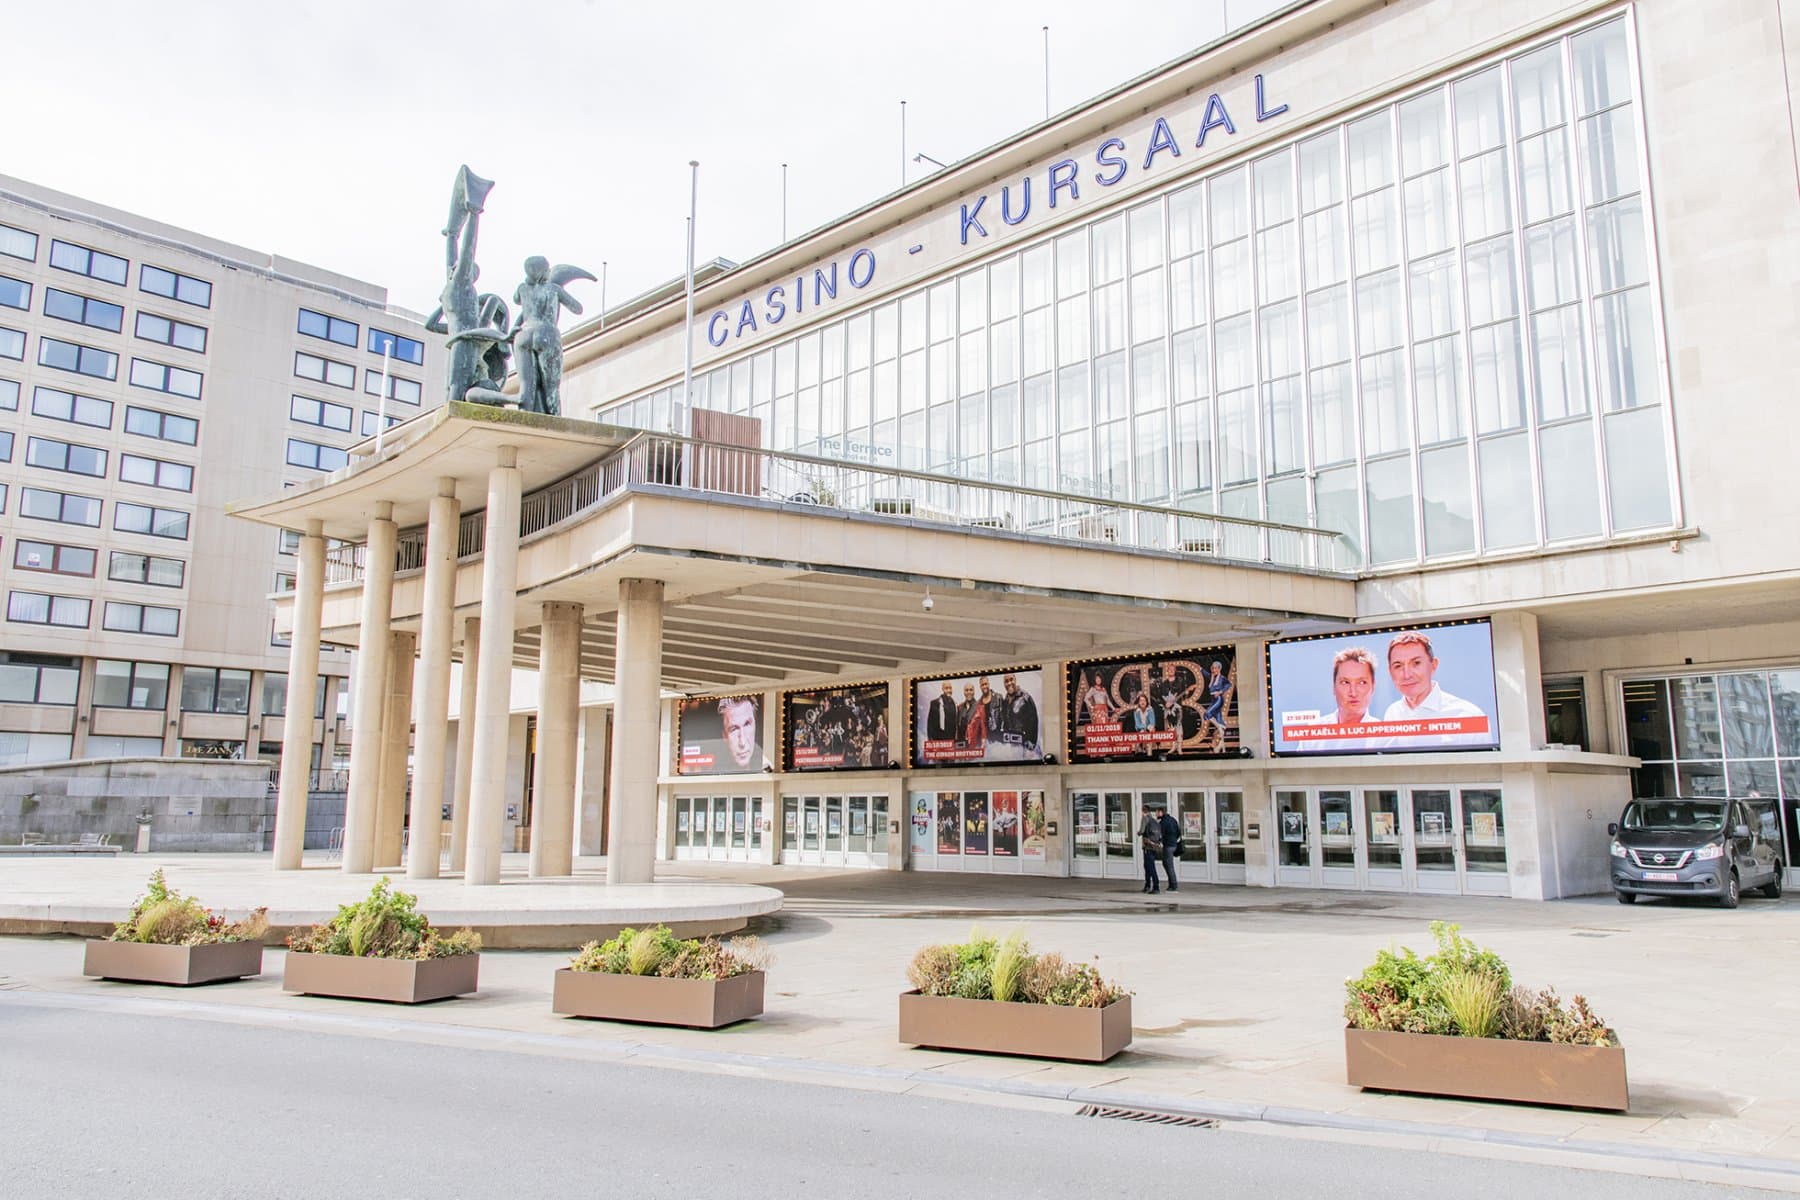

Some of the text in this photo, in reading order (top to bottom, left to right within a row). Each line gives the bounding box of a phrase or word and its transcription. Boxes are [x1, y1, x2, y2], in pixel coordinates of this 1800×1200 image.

[708, 248, 875, 347] CASINO
[960, 74, 1289, 245] KURSAAL
[1081, 477, 1121, 493] Teace
[1087, 732, 1174, 743] THANK YOU FOR THE MUSIC
[1287, 729, 1310, 738] BART
[1311, 727, 1338, 737] KAËLL
[1339, 727, 1347, 735] &
[1347, 727, 1365, 735] LUC
[1366, 724, 1422, 734] APPERMONT
[1428, 722, 1462, 732] INTIEM
